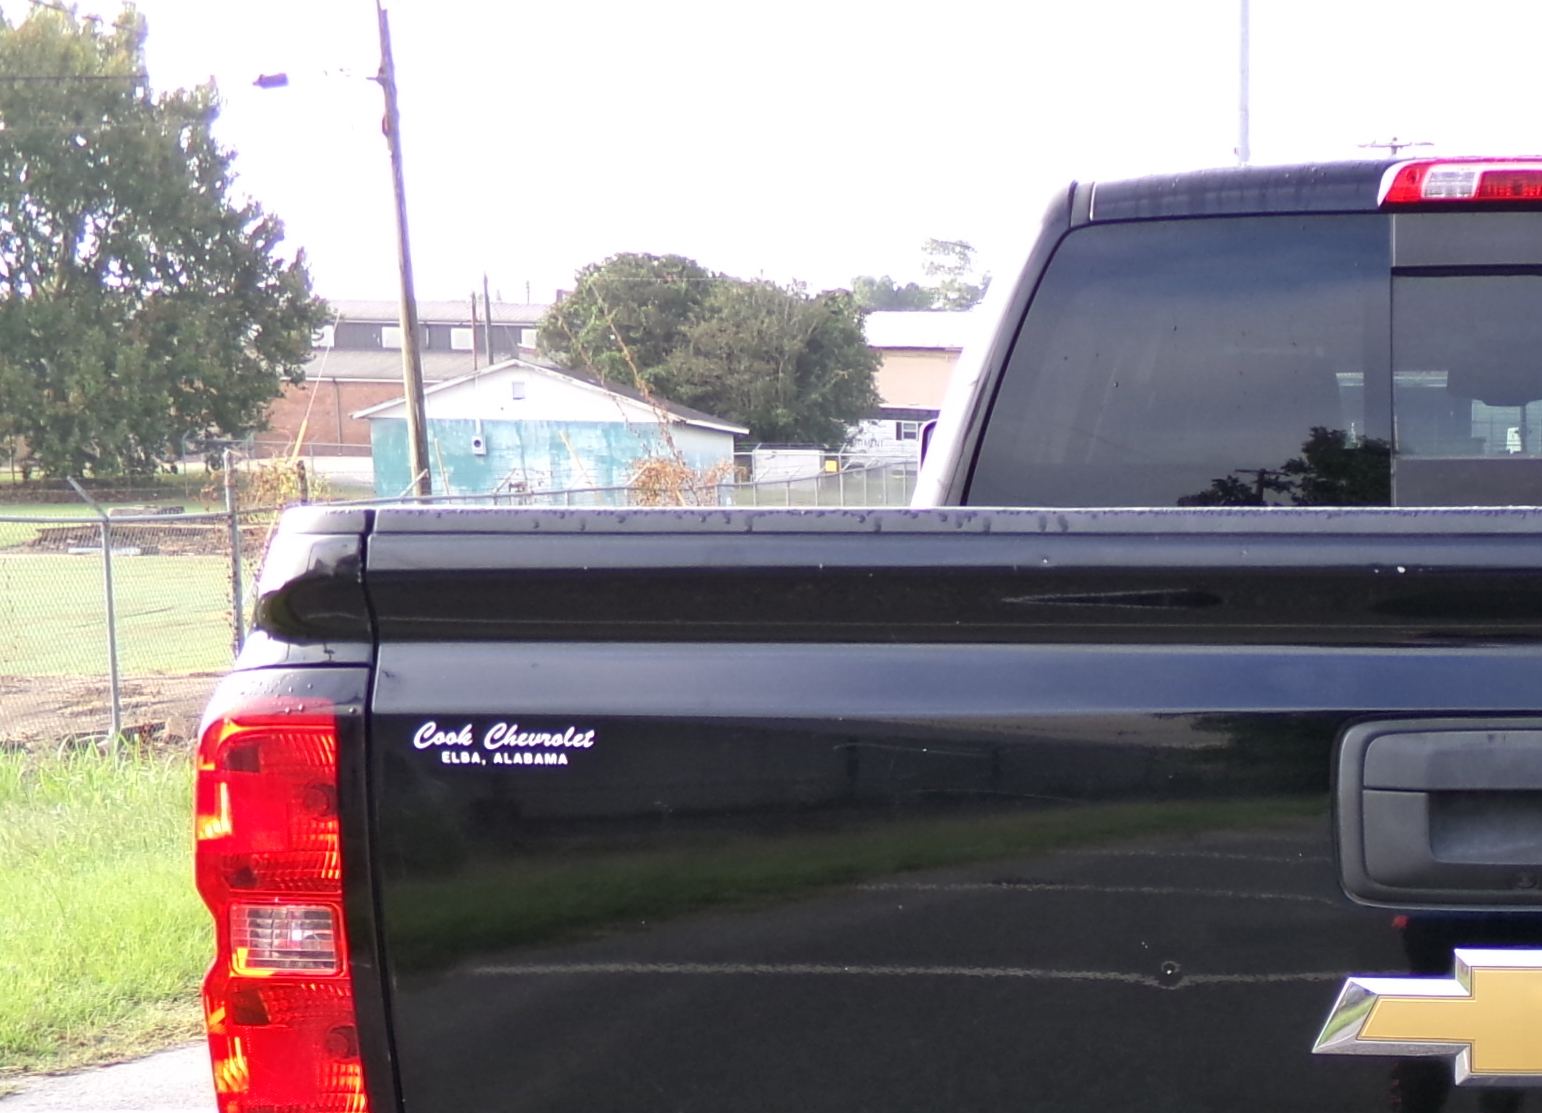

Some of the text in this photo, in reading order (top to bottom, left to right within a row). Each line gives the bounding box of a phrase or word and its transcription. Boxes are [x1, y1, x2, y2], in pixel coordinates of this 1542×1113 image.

[413, 721, 595, 750] Cook Chevrolet
[441, 750, 569, 766] ELBA, ALABAMA
